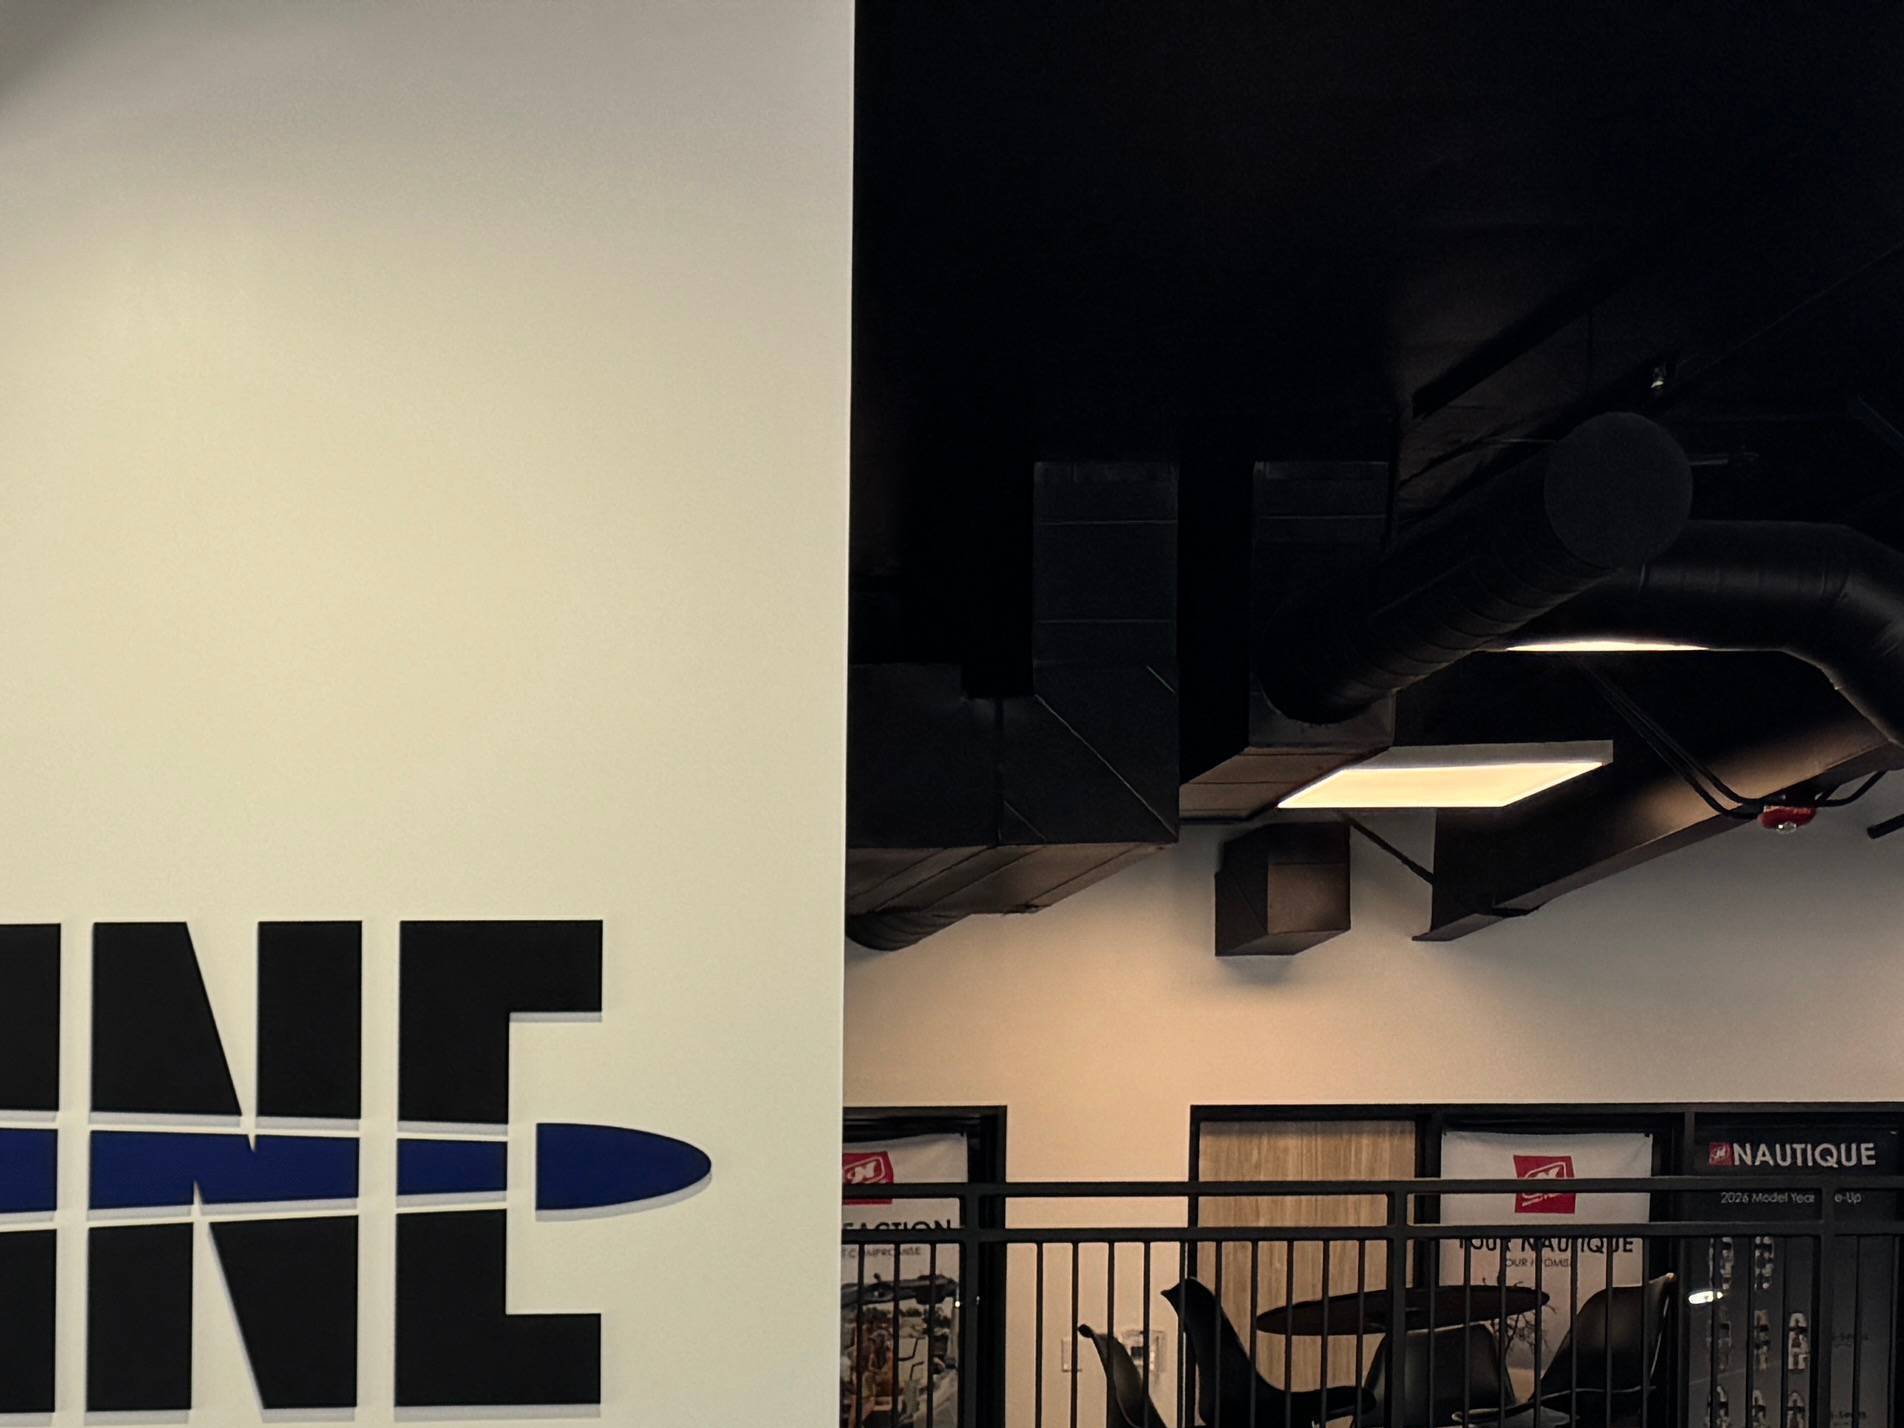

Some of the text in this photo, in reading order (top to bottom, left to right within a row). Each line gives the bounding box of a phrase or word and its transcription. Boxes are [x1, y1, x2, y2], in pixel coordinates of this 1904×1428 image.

[1733, 1143, 1877, 1168] NAUTIQUE
[1721, 1192, 1749, 1203] 2026
[1752, 1192, 1788, 1203] Model
[1792, 1192, 1815, 1203] Year
